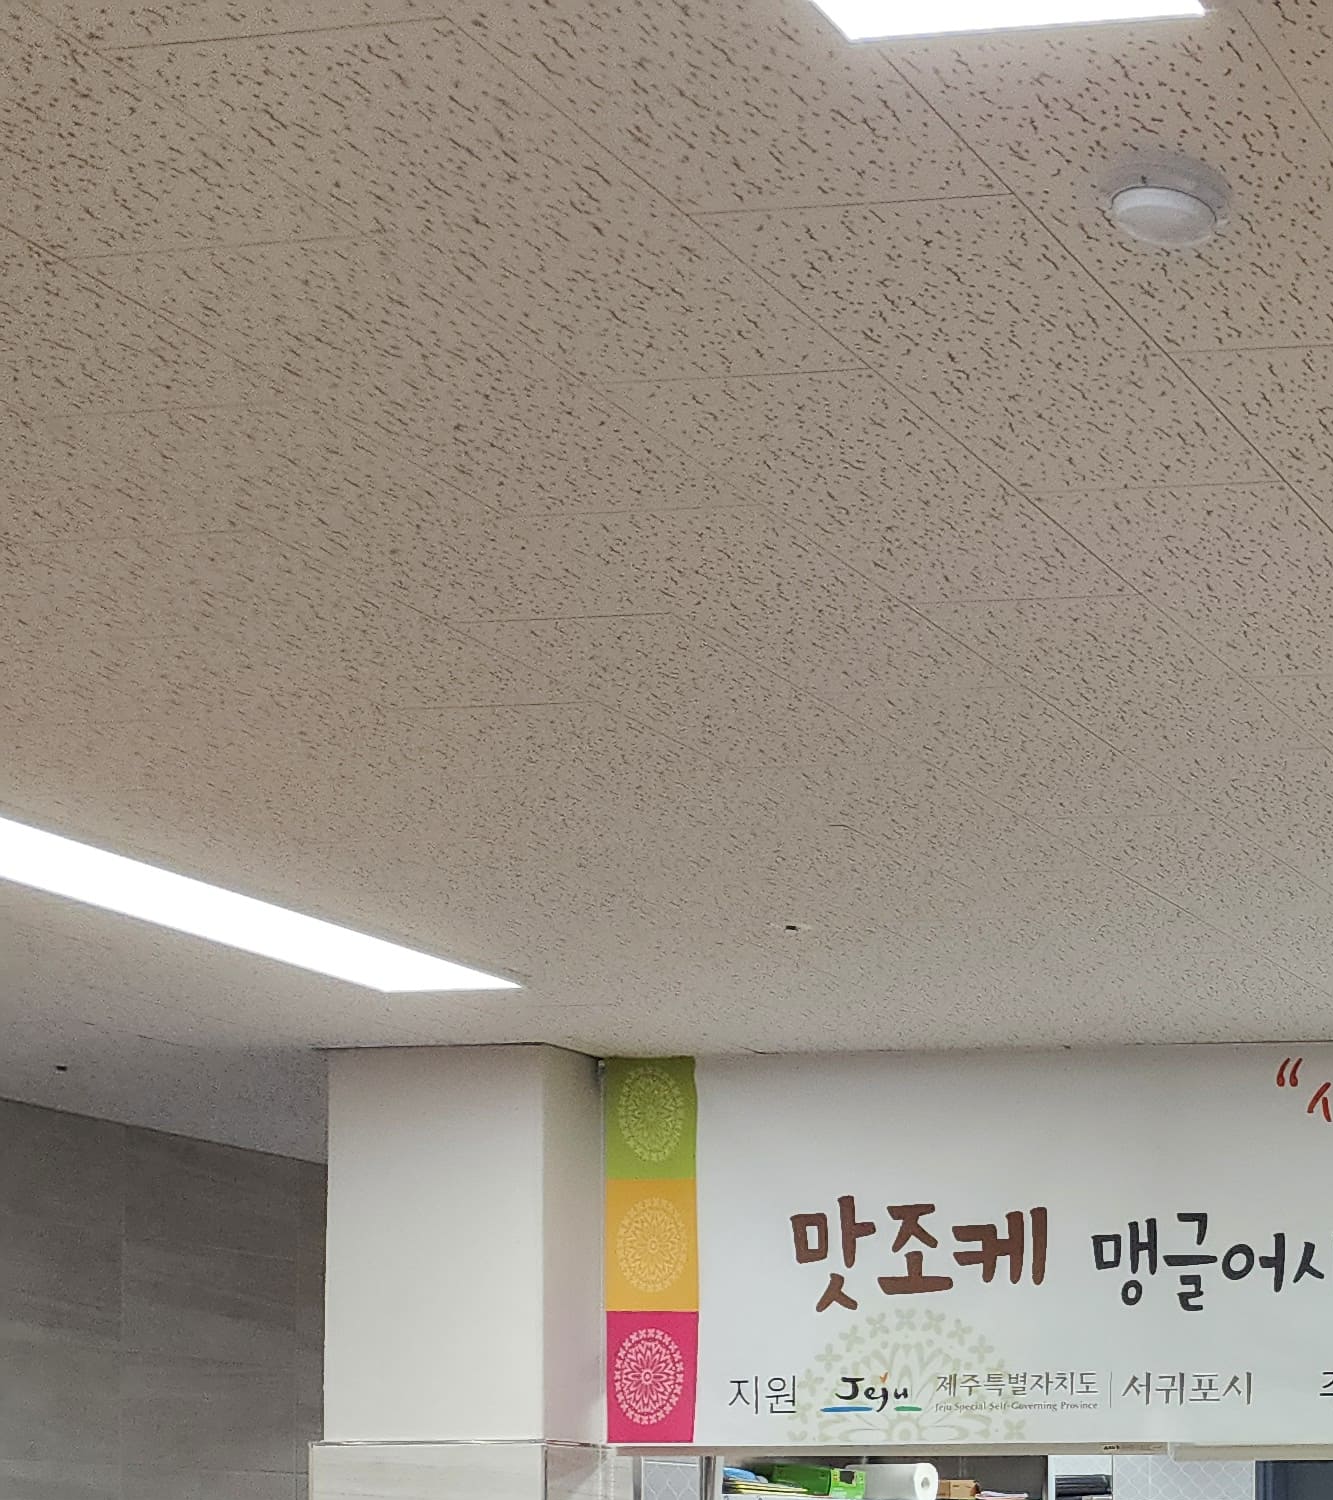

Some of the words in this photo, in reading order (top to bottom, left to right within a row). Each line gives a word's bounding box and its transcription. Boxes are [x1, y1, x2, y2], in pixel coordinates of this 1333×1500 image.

[790, 1195, 1047, 1312] 맛조케
[729, 1376, 796, 1414] 지원
[834, 1373, 909, 1412] Jeju
[936, 1372, 1098, 1397] 제주특별자치도
[1122, 1372, 1251, 1405] 서귀포시
[955, 1402, 986, 1412] Special
[990, 1401, 1057, 1411] Self-Governing
[1060, 1401, 1098, 1410] Province
